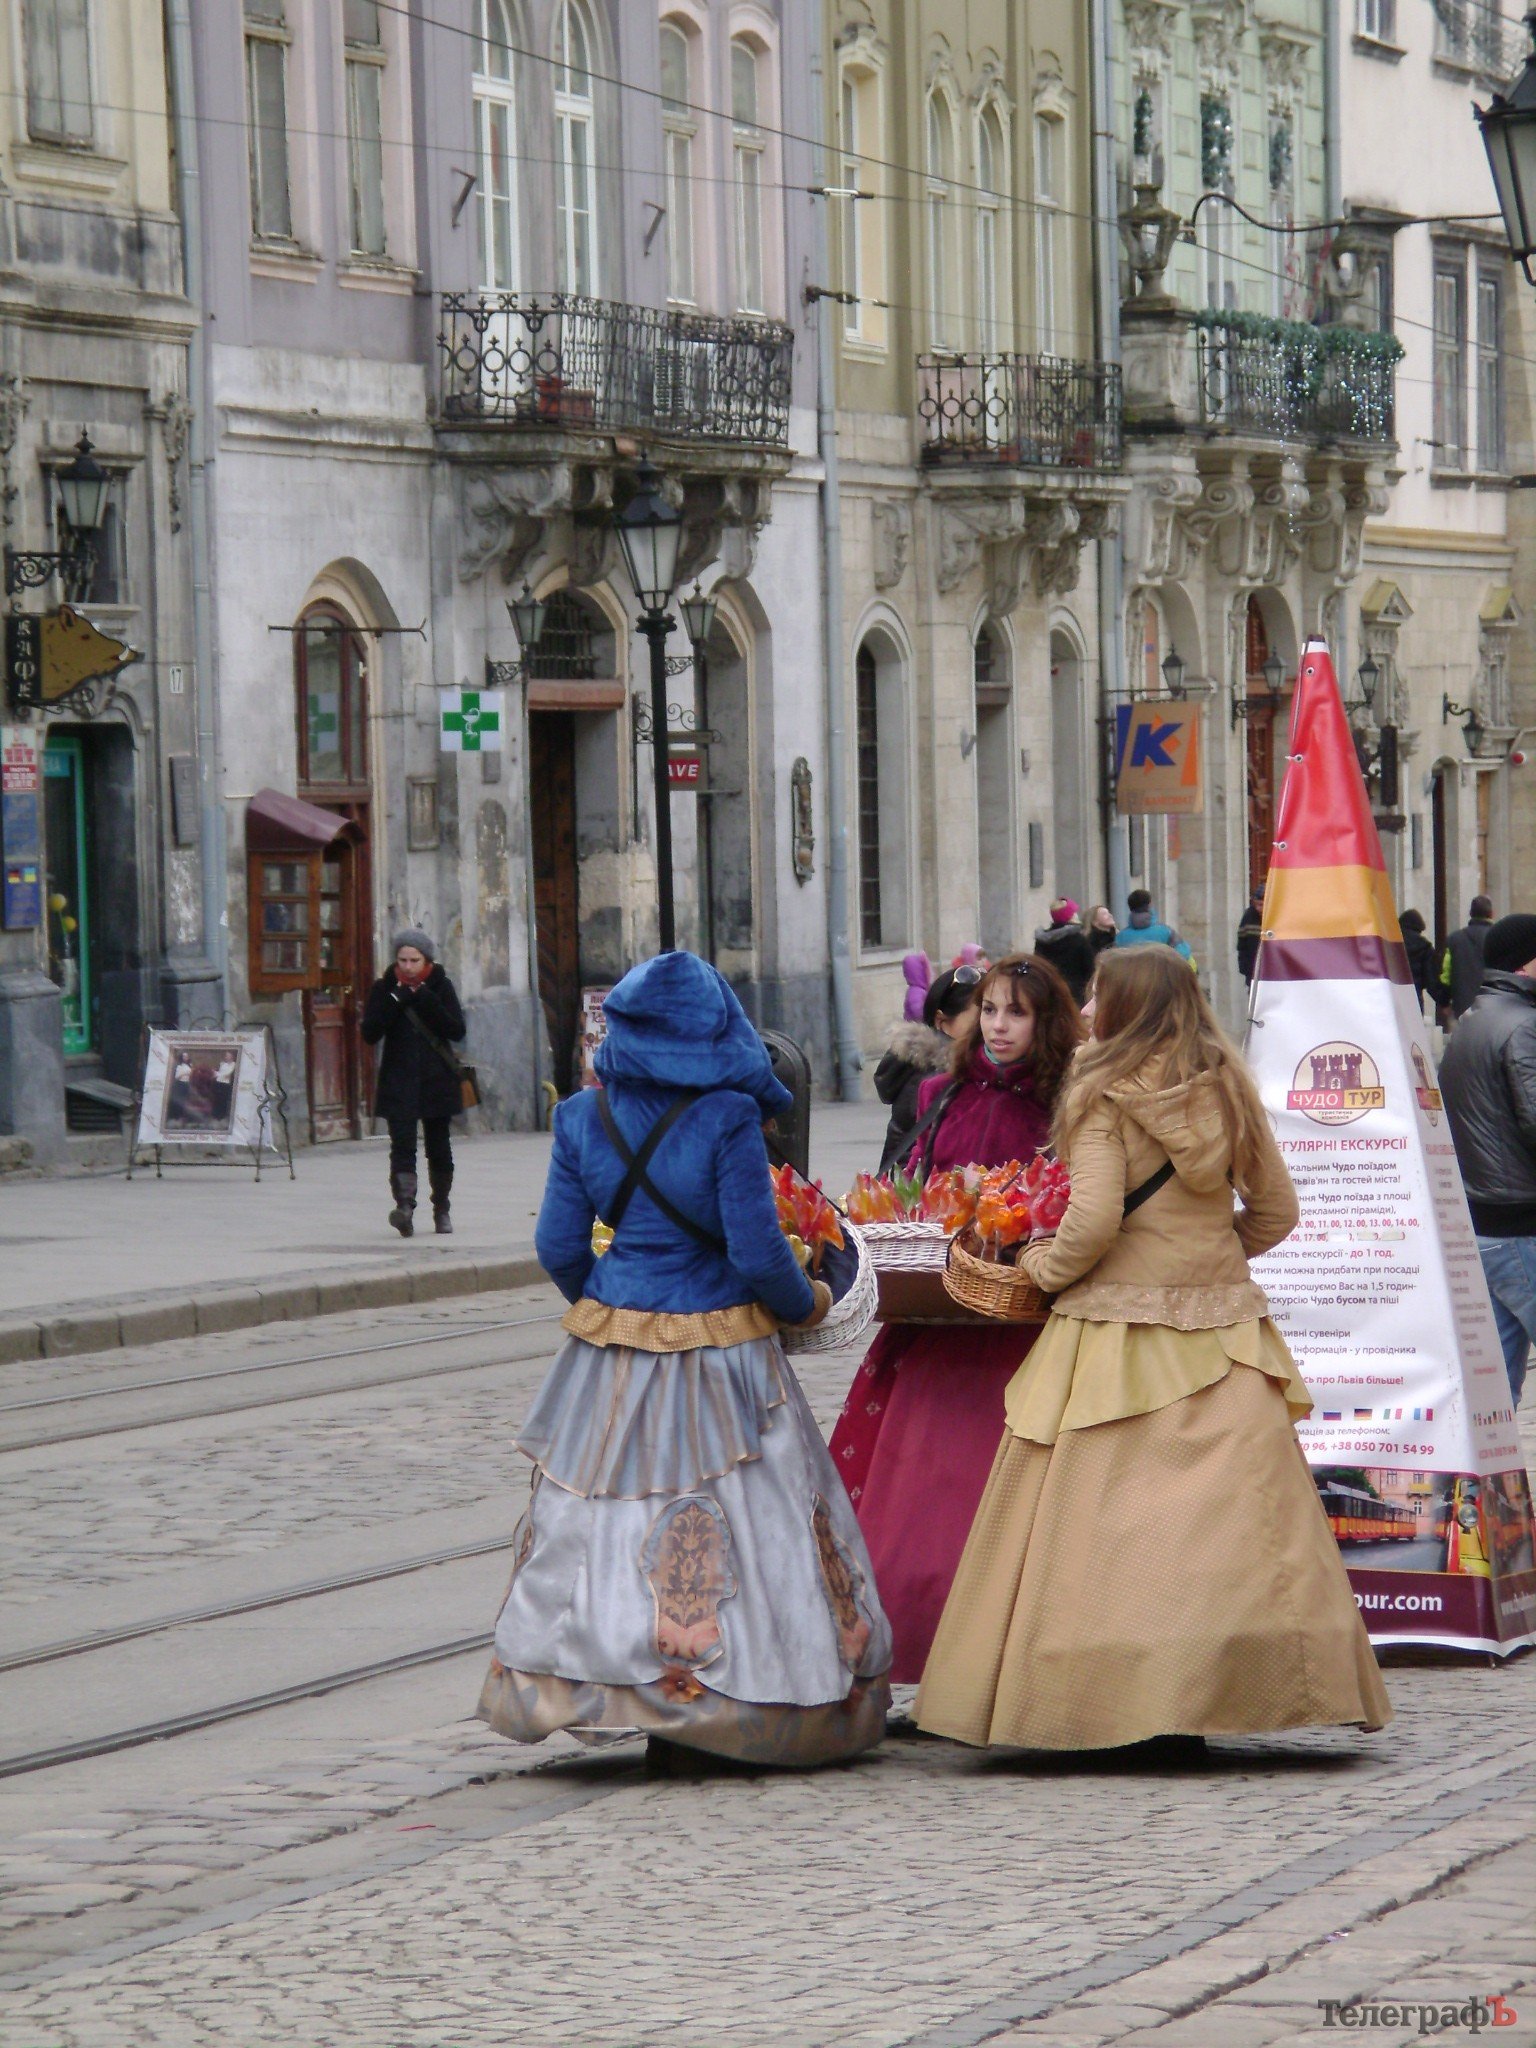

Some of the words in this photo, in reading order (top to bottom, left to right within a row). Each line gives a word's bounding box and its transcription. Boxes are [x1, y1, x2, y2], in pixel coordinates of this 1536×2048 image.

[1292, 1093, 1339, 1108] ЧУДО
[1348, 1091, 1381, 1105] ТУР
[1277, 1140, 1337, 1152] ЕГУЛЯРНІ
[1341, 1136, 1408, 1151] ЕКСКУРСІЇ
[1288, 1162, 1330, 1172] ікальним
[1332, 1162, 1356, 1173] Чудо
[1357, 1162, 1397, 1172] поїздом
[1331, 1177, 1340, 1185] та
[1342, 1175, 1373, 1184] гостей
[1375, 1174, 1401, 1184] міста!
[1318, 1193, 1342, 1204] Чудо
[1344, 1193, 1374, 1202] поїзда
[1383, 1192, 1411, 1202] площі
[1300, 1206, 1349, 1216] рекламної
[1301, 1248, 1343, 1259] екскурсії
[1350, 1250, 1364, 1260] до
[1374, 1250, 1395, 1259] год.
[1283, 1267, 1315, 1275] можна
[1317, 1265, 1362, 1276] придбати
[1363, 1266, 1382, 1276] при
[1383, 1264, 1420, 1275] посадці
[1278, 1282, 1337, 1292] запрошуємо
[1338, 1282, 1355, 1291] Вас
[1357, 1283, 1368, 1291] на
[1371, 1282, 1384, 1292] 1,5
[1386, 1283, 1417, 1292] годин-
[1267, 1296, 1309, 1306] кскурсію
[1310, 1296, 1335, 1306] Чудо
[1336, 1295, 1367, 1306] бусом
[1368, 1297, 1378, 1305] та
[1379, 1295, 1400, 1305] піші
[1309, 1329, 1351, 1341] сувеніри
[1293, 1344, 1348, 1356] інформація
[1355, 1347, 1360, 1355] у
[1362, 1345, 1417, 1356] провідника
[1316, 1376, 1335, 1386] про
[1337, 1375, 1364, 1384] Львів
[1366, 1375, 1404, 1385] більше!
[1324, 1428, 1335, 1436] за
[1331, 1441, 1351, 1451] +38
[1354, 1441, 1376, 1452] 050
[1379, 1442, 1399, 1453] 701
[1402, 1444, 1418, 1455] 54
[1420, 1445, 1435, 1455] 99
[1354, 1592, 1443, 1612] our.com
